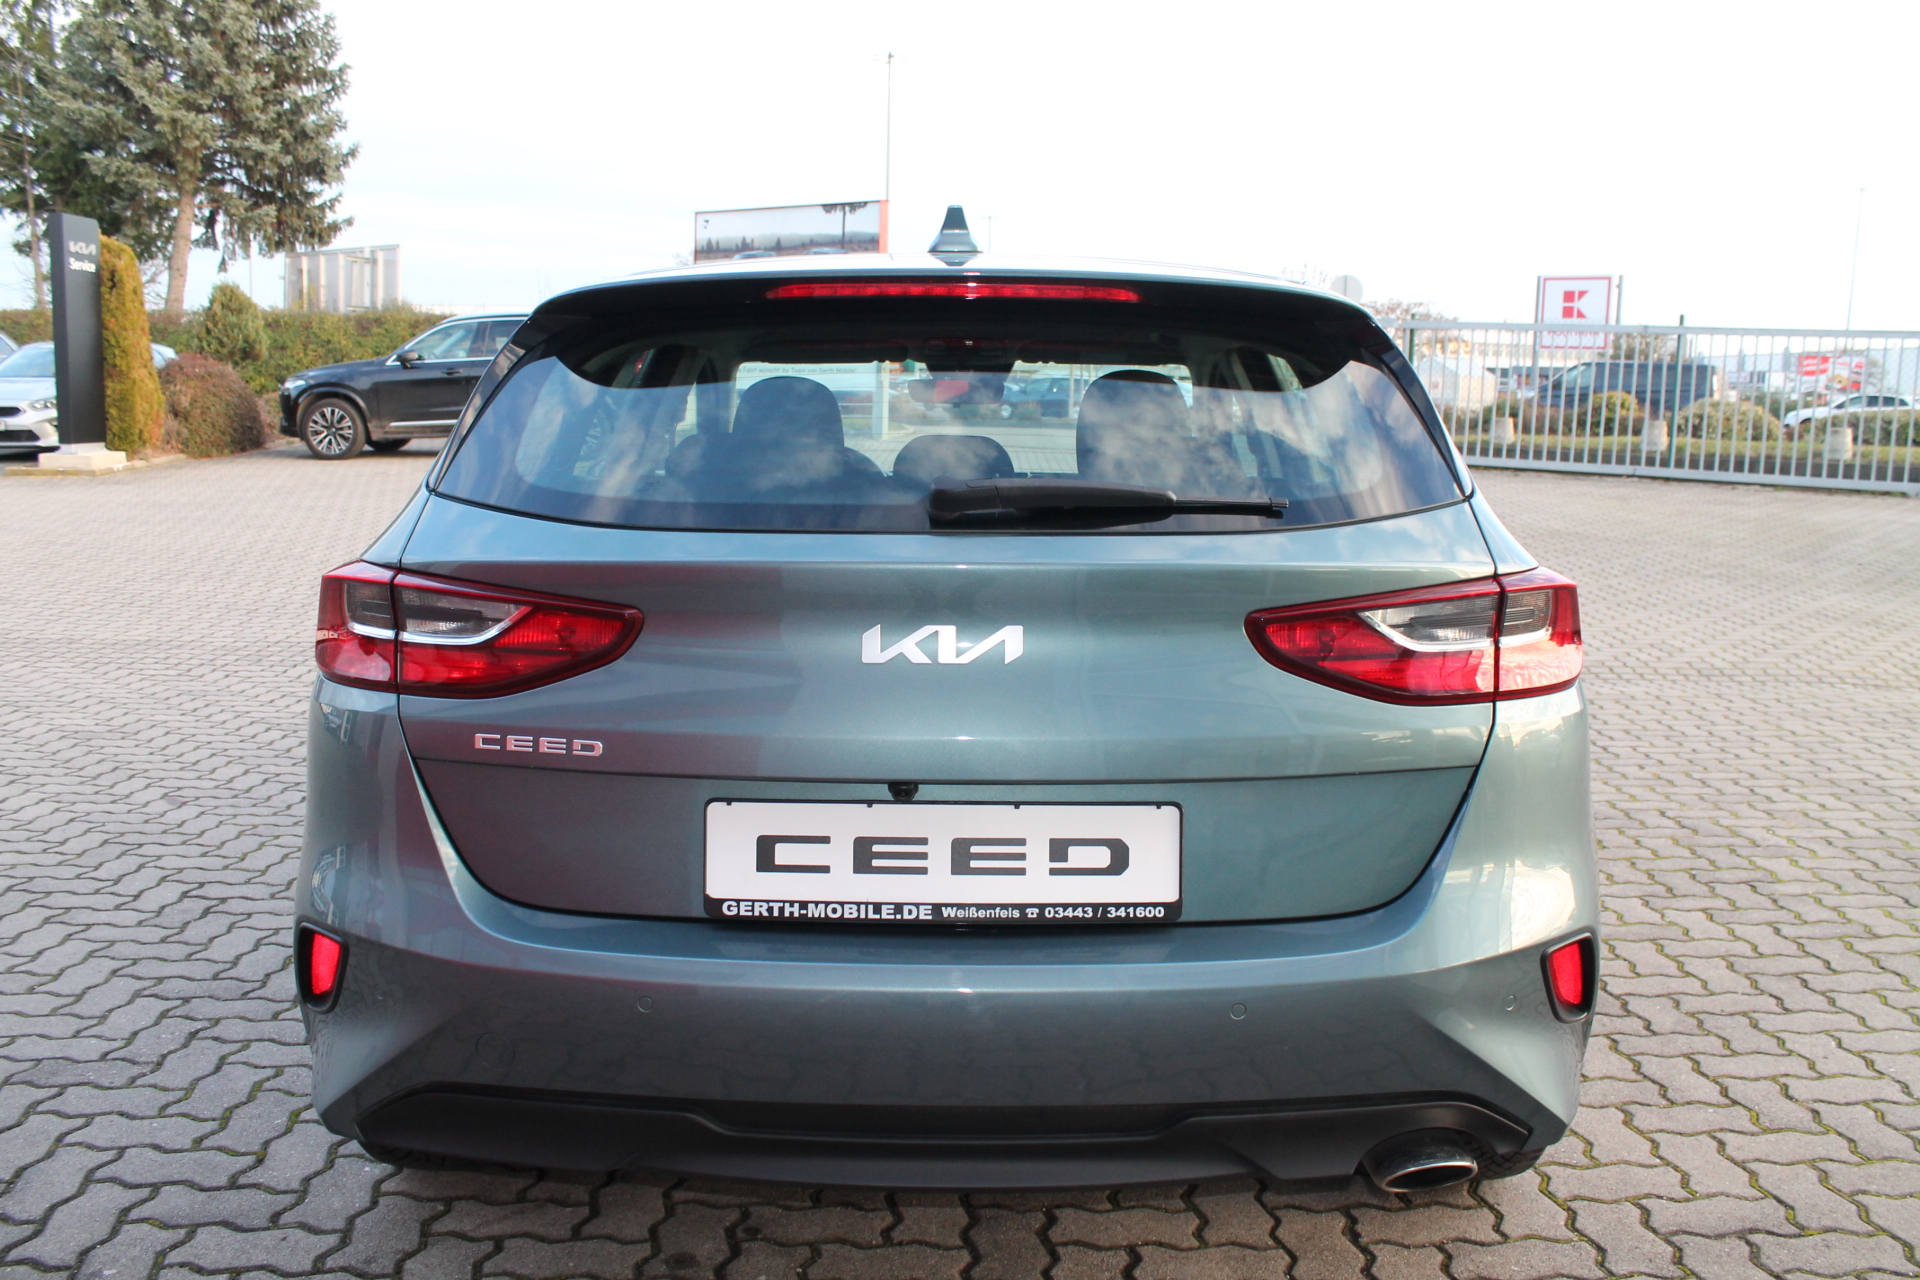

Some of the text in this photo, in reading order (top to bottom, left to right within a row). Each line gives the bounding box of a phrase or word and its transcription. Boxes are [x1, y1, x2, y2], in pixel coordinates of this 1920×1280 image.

[69, 257, 96, 273] Service
[861, 624, 1024, 665] KIA
[474, 733, 603, 757] CEED
[756, 835, 1130, 876] CEED
[722, 901, 933, 920] GERTH-MOBILE.DE
[941, 906, 1020, 918] Weißenfels
[1044, 906, 1093, 918] 03443
[1106, 906, 1165, 918] 341600
